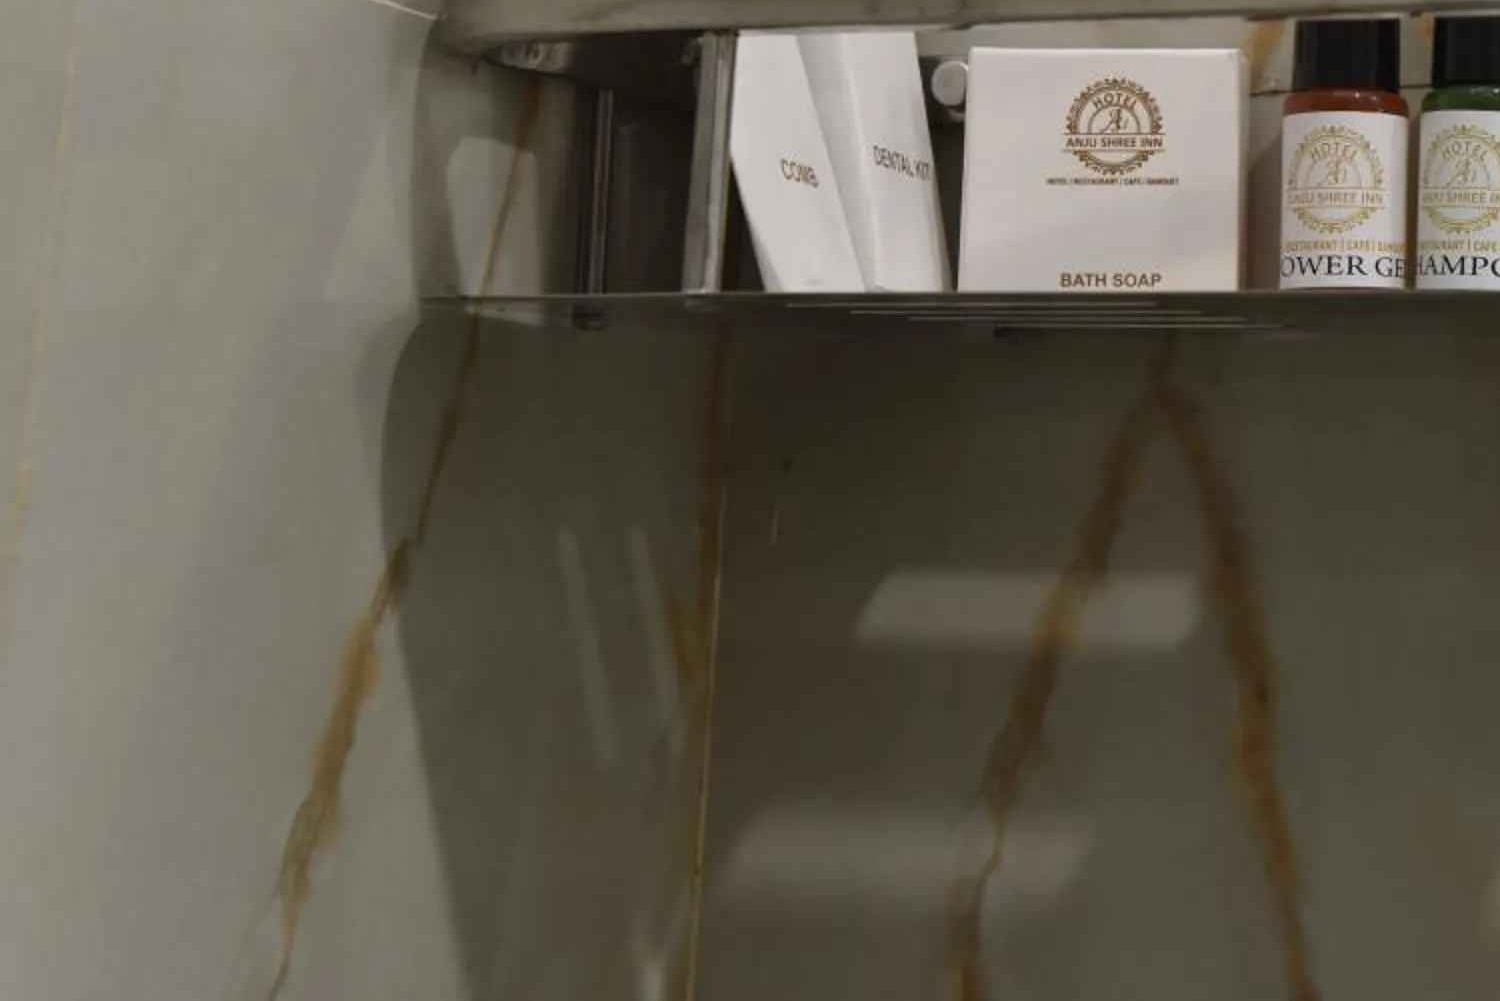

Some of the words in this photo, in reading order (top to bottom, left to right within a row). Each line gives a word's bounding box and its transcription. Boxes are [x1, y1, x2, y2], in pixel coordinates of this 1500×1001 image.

[1092, 93, 1137, 109] HOTEL
[1065, 137, 1097, 148] ANJU
[1100, 137, 1137, 148] SHREE
[1140, 137, 1163, 148] INN
[873, 145, 914, 177] DENTAL
[914, 160, 931, 181] KIT
[1360, 192, 1384, 204] INN
[1281, 254, 1367, 278] OWER
[1375, 256, 1405, 279] GE
[1060, 272, 1107, 288] BATH
[1112, 272, 1162, 288] SOAP
